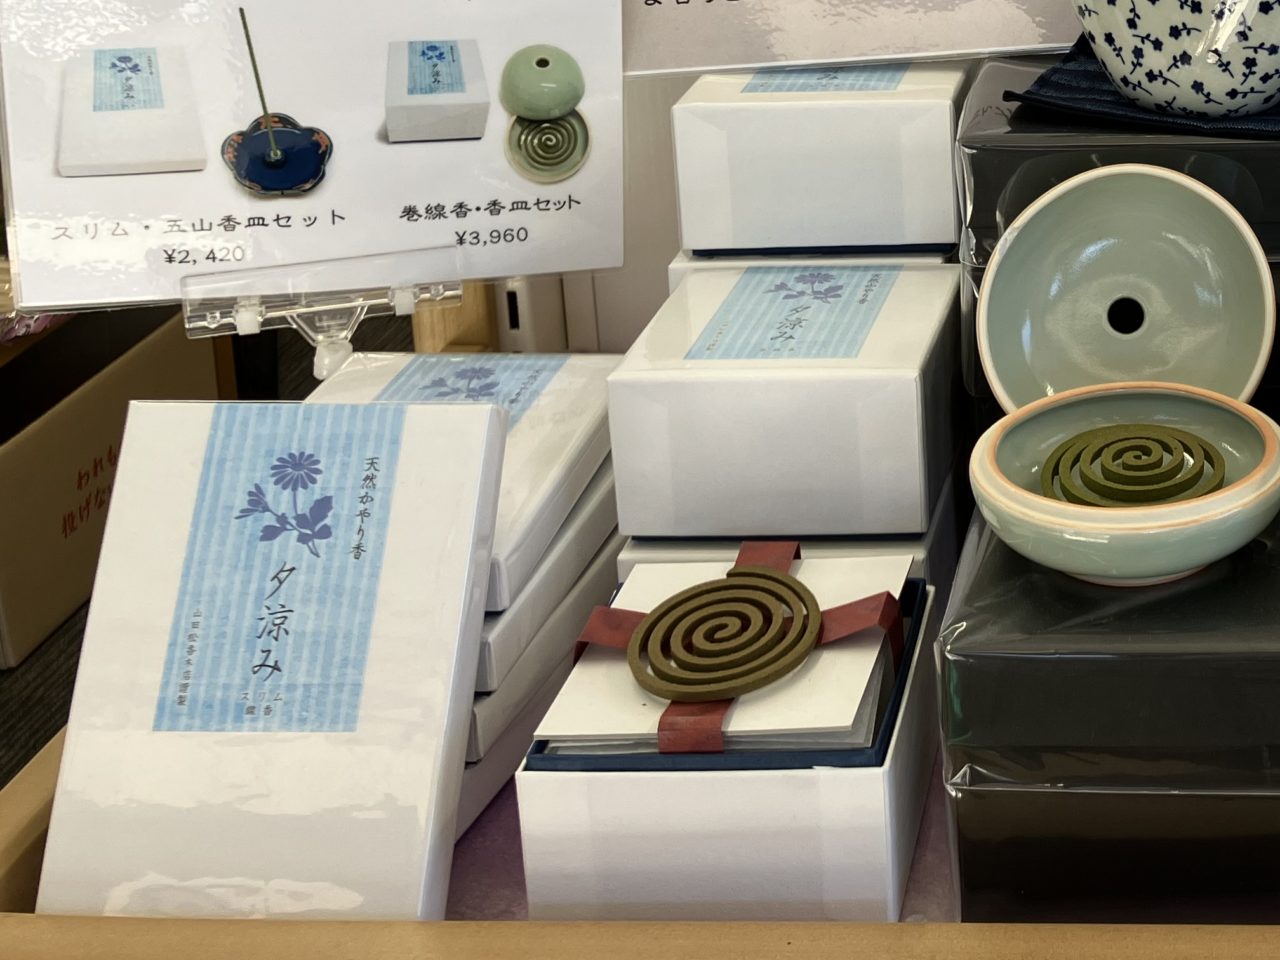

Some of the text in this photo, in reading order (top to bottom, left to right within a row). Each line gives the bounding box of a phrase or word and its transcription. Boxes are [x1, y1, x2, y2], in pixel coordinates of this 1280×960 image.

[399, 194, 581, 223] 巻線香・香皿セット
[455, 226, 529, 247] ¥3,960
[348, 456, 381, 560] 天然かやり香
[251, 561, 296, 682] 夕涼み
